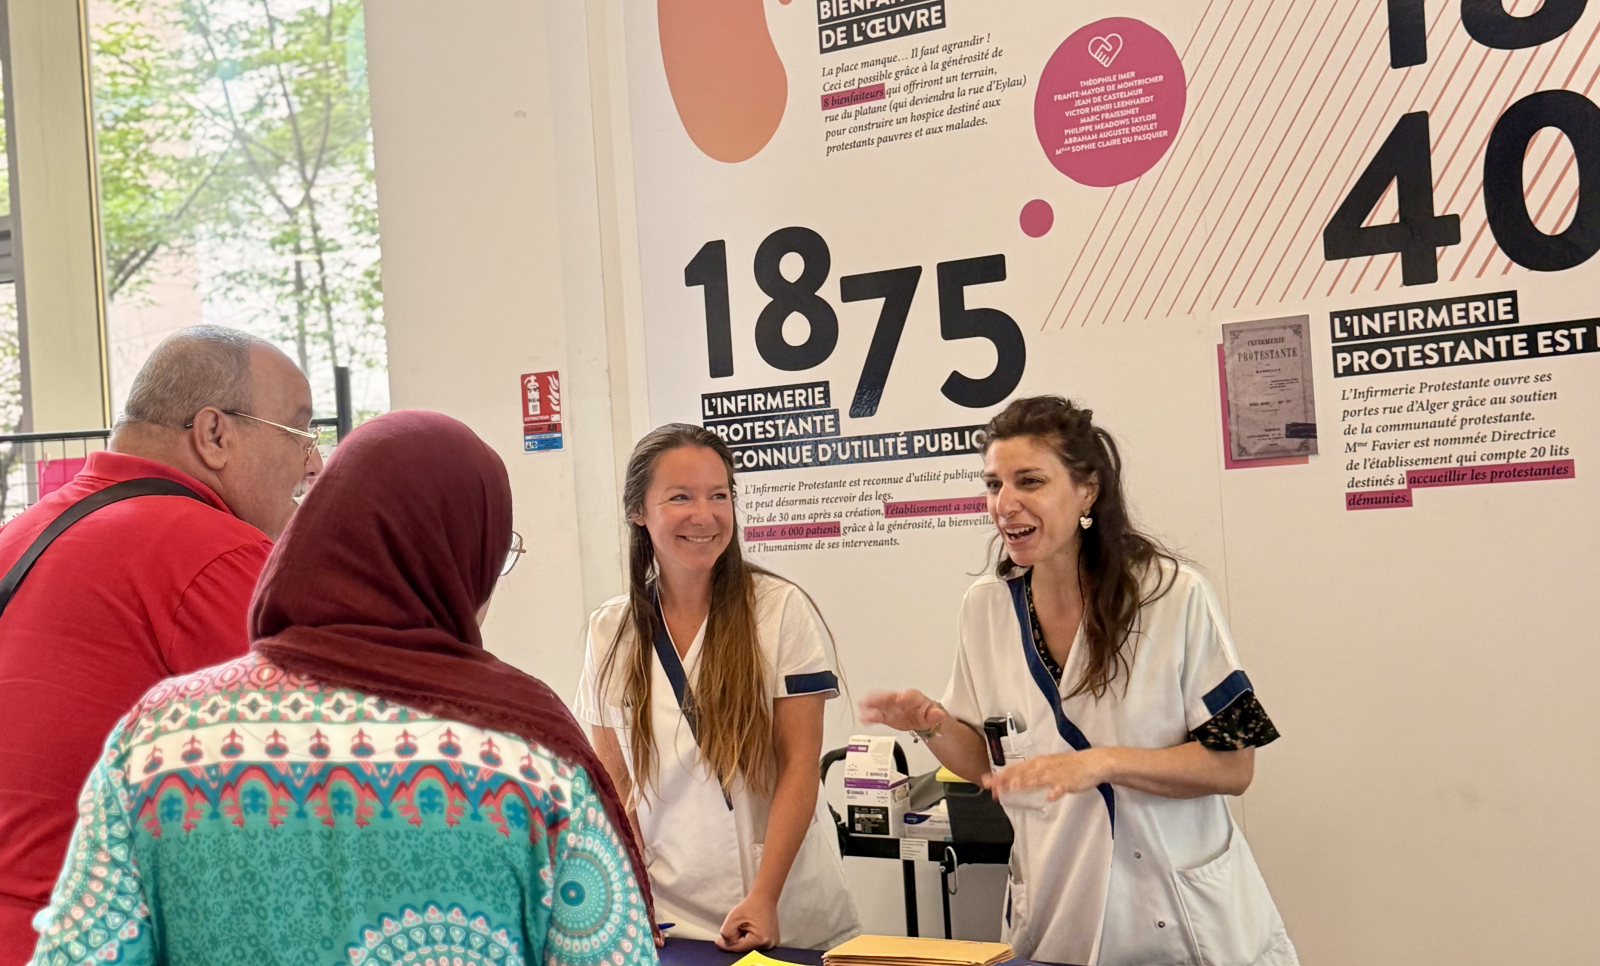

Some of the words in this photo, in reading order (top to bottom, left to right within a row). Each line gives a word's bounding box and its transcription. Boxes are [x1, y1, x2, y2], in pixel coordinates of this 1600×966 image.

[822, 27, 847, 48] DE
[853, 7, 942, 42] L’ŒUVRE
[822, 67, 833, 77] La
[835, 63, 858, 77] place
[861, 55, 908, 69] manque...
[911, 48, 919, 60] Il
[919, 45, 939, 60] faut
[942, 35, 984, 54] agrandir
[987, 33, 990, 42] !
[823, 80, 841, 92] Ceci
[844, 78, 855, 88] est
[858, 70, 892, 89] possible
[894, 66, 919, 81] grâce
[922, 62, 927, 72] à
[930, 60, 939, 70] la
[941, 49, 989, 71] générosité
[992, 48, 1003, 58] de
[1080, 75, 1116, 87] THÉOPHILE
[1118, 71, 1135, 80] IMER
[1117, 75, 1163, 89] MONTRICHER
[824, 98, 828, 107] 8
[832, 90, 884, 106] bienfaiteurs
[884, 84, 900, 99] qui
[903, 76, 943, 94] offriront
[946, 75, 958, 83] un
[961, 66, 997, 80] terrain,
[1074, 98, 1091, 106] JEAN
[1103, 88, 1143, 101] CASTELMUR
[824, 114, 839, 123] rue
[840, 108, 853, 120] du
[854, 105, 887, 120] platane
[889, 98, 907, 112] (qui
[910, 90, 954, 106] deviendra
[957, 87, 966, 97] la
[968, 86, 984, 95] rue
[986, 75, 1026, 92] d’Eylau)
[1065, 107, 1090, 117] VICTOR
[1091, 103, 1112, 112] HENRI
[1114, 95, 1154, 108] LEENHARDT
[825, 128, 846, 141] pour
[848, 118, 893, 134] construire
[896, 116, 908, 125] un
[910, 109, 944, 122] hospice
[947, 100, 980, 115] destiné
[982, 99, 1001, 109] aux
[1064, 125, 1093, 135] PHILIPPE
[1095, 118, 1130, 130] MEADOWS
[1131, 114, 1156, 123] TAYLOR
[1080, 114, 1100, 123] MARC
[1101, 107, 1139, 120] FRAISSINET
[826, 138, 874, 156] protestants
[876, 132, 912, 147] pauvres
[915, 128, 923, 137] et
[925, 126, 943, 135] aux
[946, 116, 988, 132] malades.
[1064, 134, 1098, 144] ABRAHAM
[1099, 127, 1130, 138] AUGUSTE
[1131, 122, 1158, 133] ROULET
[1072, 142, 1096, 152] SOPHIE
[1098, 138, 1121, 147] CLAIRE
[1122, 136, 1132, 144] DU
[1134, 130, 1168, 141] PASQUIER
[684, 226, 1026, 418] 1875
[1334, 298, 1513, 338] L’INFIRMERIE
[1238, 347, 1298, 362] PROTESTANTE
[1337, 334, 1528, 373] PROTESTANTE
[1538, 328, 1586, 353] EST
[1341, 384, 1415, 402] L’Infirmerie
[1419, 378, 1490, 393] Protestante
[1494, 376, 1530, 386] ouvre
[1534, 373, 1552, 383] ses
[704, 387, 824, 416] L’INFIRMERIE
[1342, 406, 1379, 421] portes
[1383, 406, 1403, 414] rue
[1406, 399, 1449, 414] d’Alger
[1452, 396, 1486, 412] grâce
[1490, 396, 1506, 405] au
[1510, 390, 1557, 404] soutien
[1344, 424, 1357, 435] de
[1361, 423, 1372, 434] la
[1376, 415, 1457, 433] communauté
[1460, 411, 1534, 430] protestante.
[732, 445, 812, 468] CONNUE
[818, 432, 908, 461] D’UTILITÉ
[1372, 439, 1410, 451] Favier
[1414, 438, 1430, 448] est
[1434, 432, 1487, 446] nommée
[1491, 428, 1556, 442] Directrice
[1346, 460, 1360, 470] de
[1364, 454, 1452, 470] l’établissement
[1456, 451, 1476, 466] qui
[1480, 449, 1526, 463] compte
[1530, 446, 1546, 458] 20
[1550, 445, 1569, 456] lits
[745, 482, 796, 496] L’Infirmerie
[798, 479, 846, 491] Protestante
[849, 478, 860, 488] est
[863, 477, 903, 486] reconnue
[906, 471, 941, 483] d’utilité
[1347, 474, 1394, 488] destinés
[1398, 474, 1405, 485] à
[1409, 470, 1467, 484] accueillir
[1470, 469, 1486, 480] les
[1488, 466, 1568, 483] protestantes
[746, 501, 753, 509] et
[755, 500, 773, 511] peut
[776, 496, 819, 507] désormais
[822, 493, 856, 504] recevoir
[859, 492, 872, 502] des
[875, 491, 893, 504] legs.
[1348, 492, 1409, 506] démunies.
[747, 514, 764, 524] Près
[766, 513, 776, 522] de
[778, 512, 789, 522] 30
[808, 510, 831, 522] après
[845, 507, 883, 518] création,
[886, 503, 951, 515] l’établissement
[962, 503, 987, 512] soign
[748, 528, 764, 541] plus
[767, 528, 776, 537] de
[781, 528, 786, 536] 6
[789, 524, 804, 536] 000
[805, 524, 840, 537] patients
[842, 523, 866, 536] grâce
[868, 522, 874, 531] à
[876, 521, 884, 531] la
[886, 518, 934, 533] générosité,
[938, 518, 946, 528] la
[748, 545, 756, 553] et
[758, 542, 813, 552] l’humanisme
[815, 540, 825, 549] de
[842, 537, 899, 548] intervenants.
